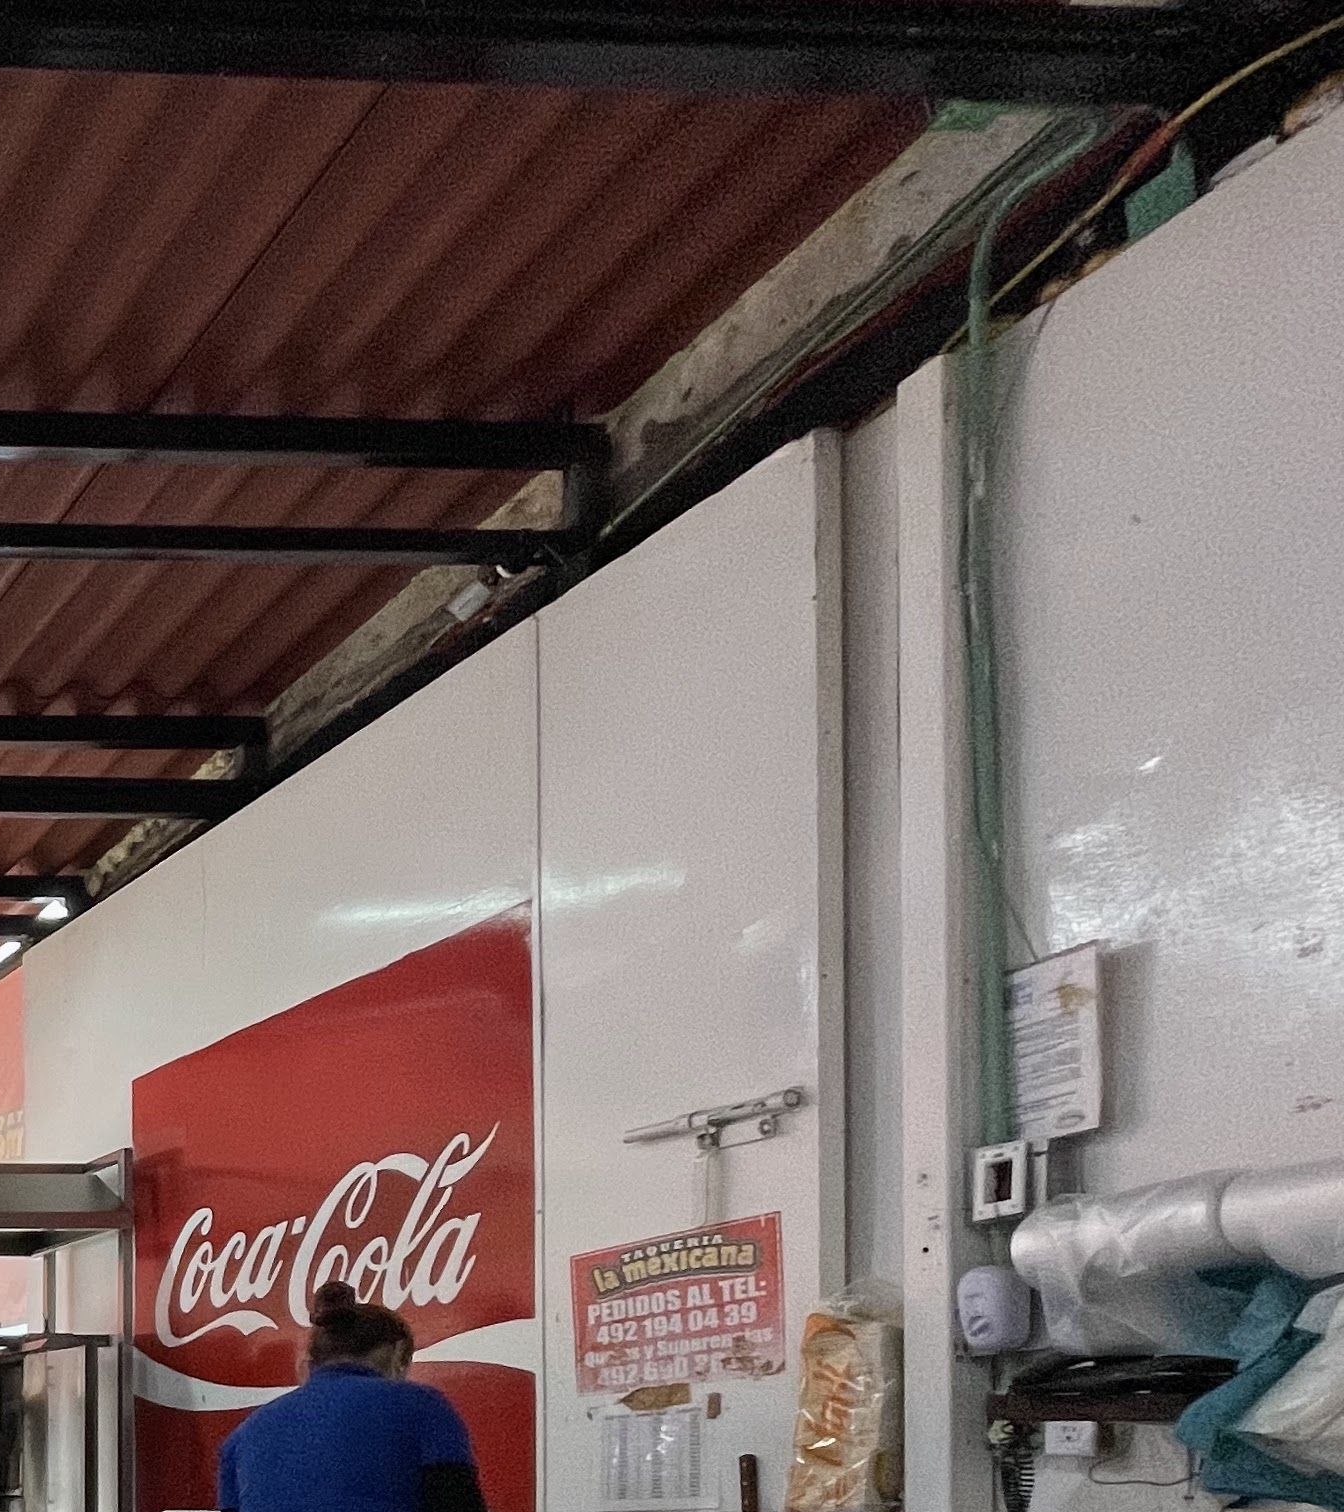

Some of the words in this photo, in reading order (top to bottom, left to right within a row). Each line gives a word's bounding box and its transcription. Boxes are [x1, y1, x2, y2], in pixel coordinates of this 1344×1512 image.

[154, 1120, 501, 1348] Coca-Cola
[620, 1234, 723, 1263] TAQUERIA
[592, 1268, 620, 1293] la
[622, 1243, 755, 1283] mexicana
[587, 1289, 680, 1325] PEDIDOS
[686, 1283, 714, 1308] AL
[596, 1321, 639, 1346] 492
[643, 1312, 682, 1339] 194
[687, 1307, 719, 1332] 04
[725, 1301, 758, 1325] 39
